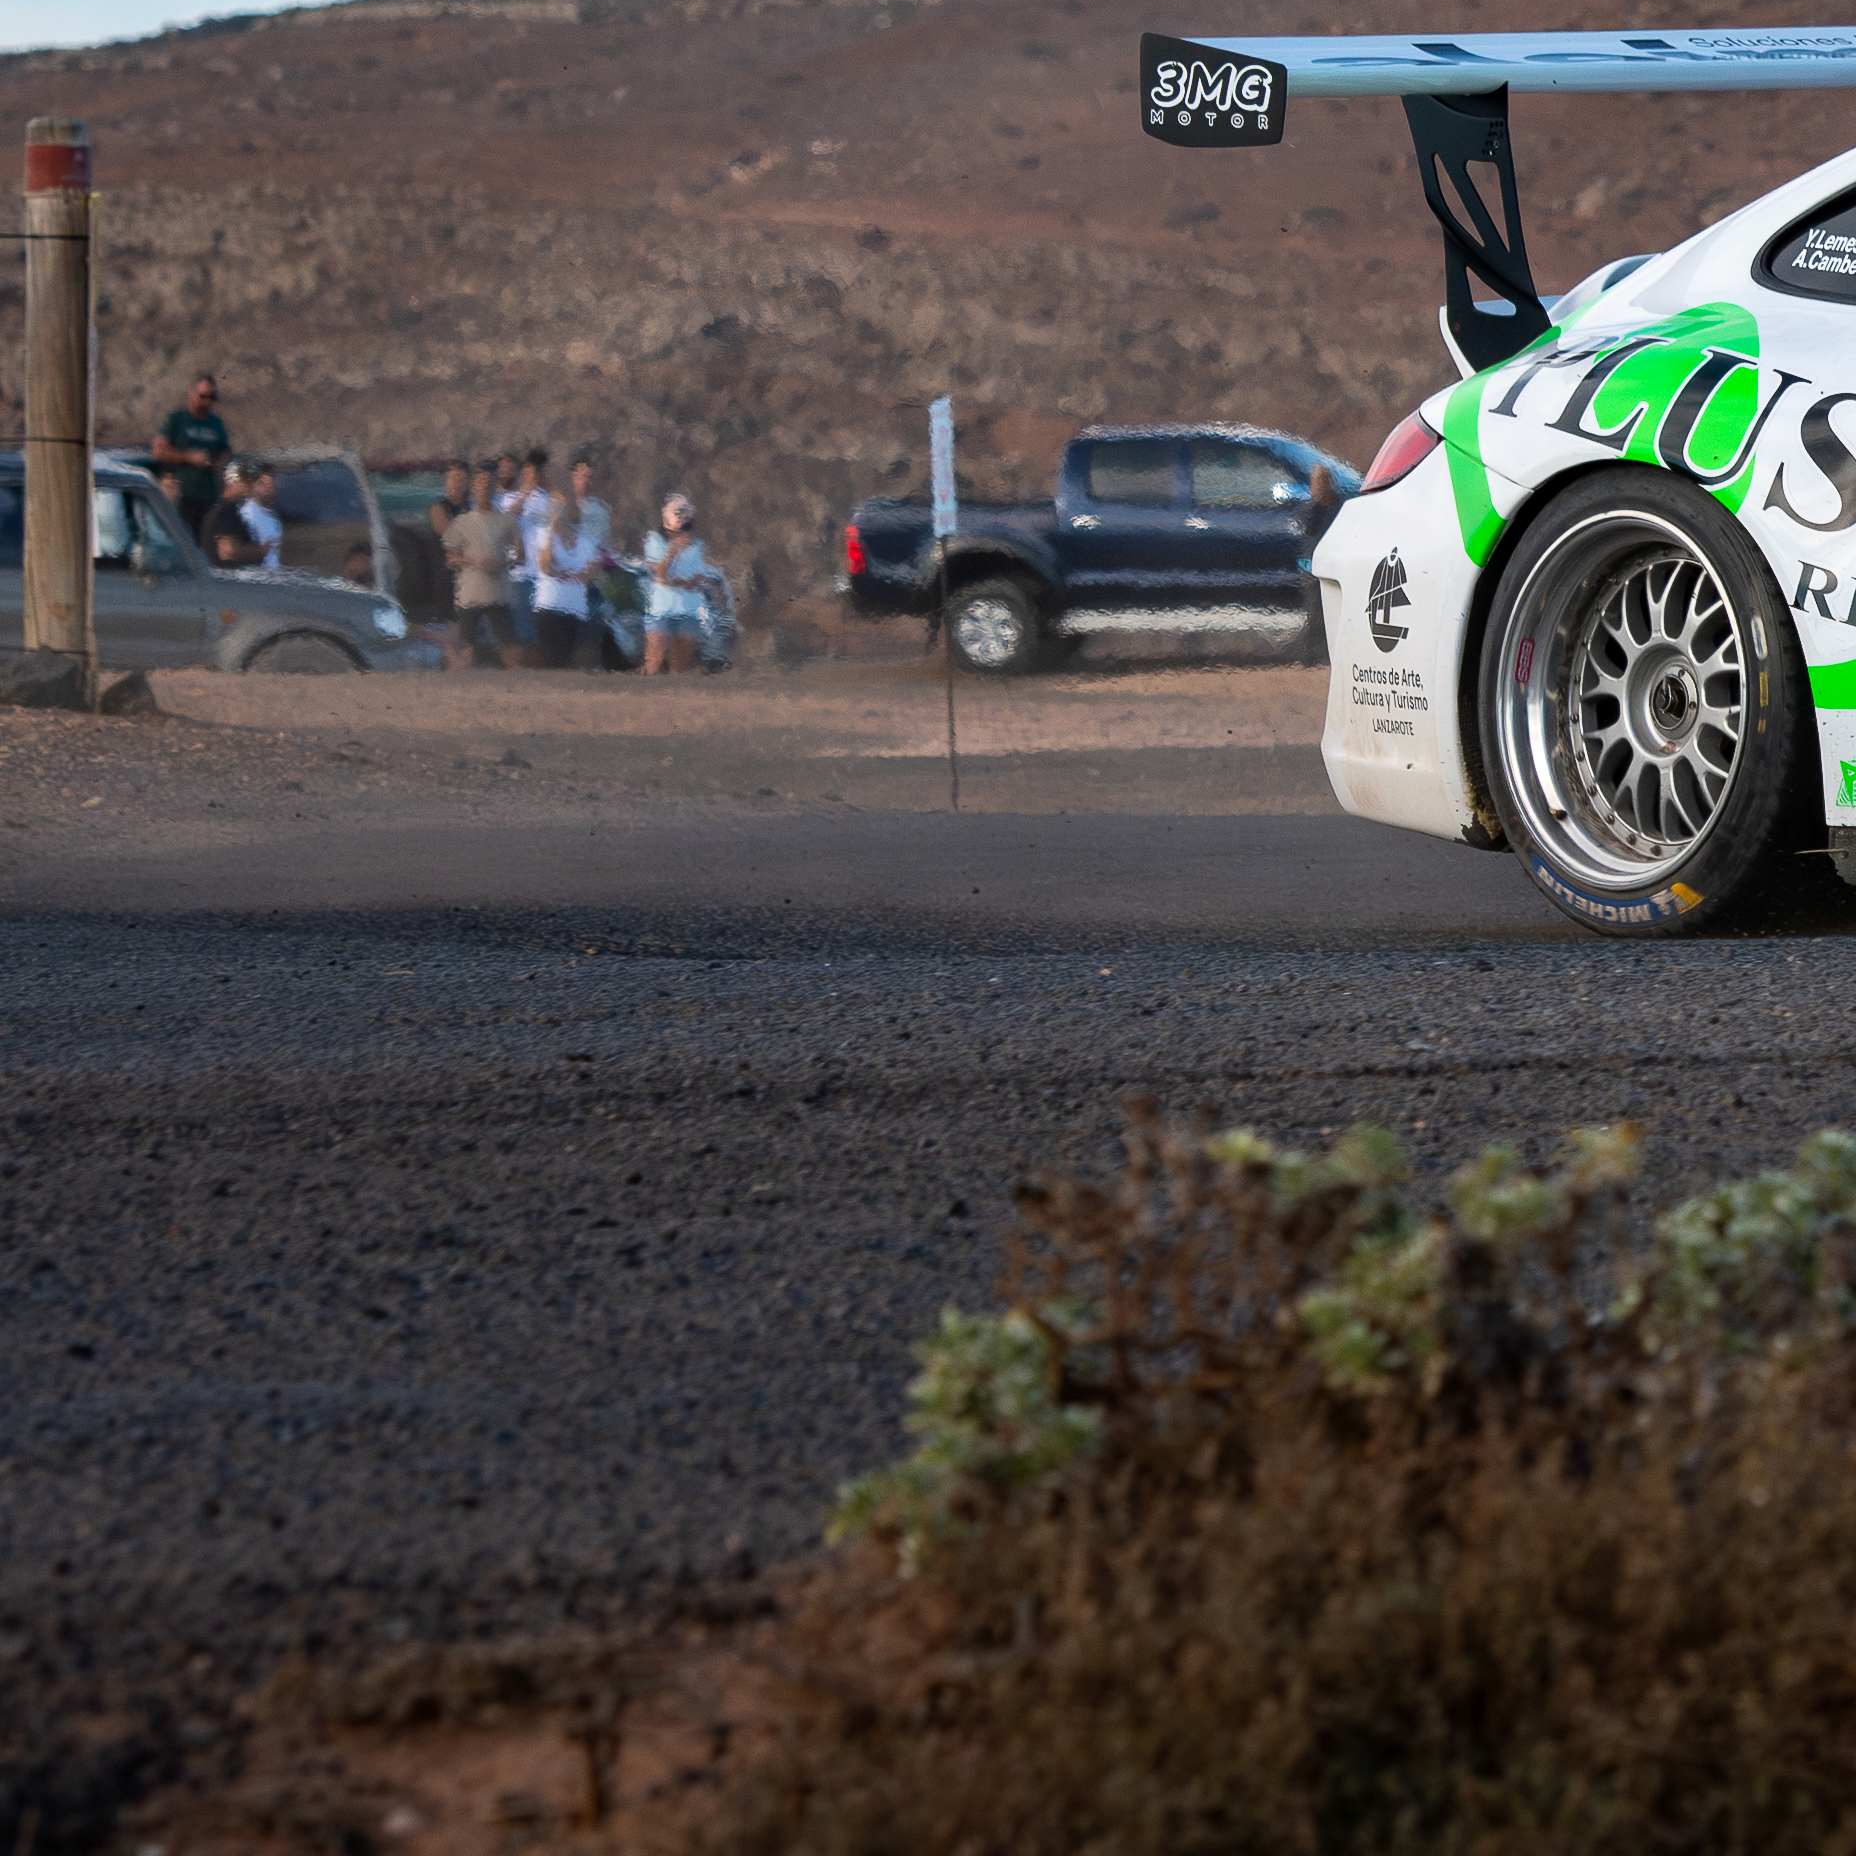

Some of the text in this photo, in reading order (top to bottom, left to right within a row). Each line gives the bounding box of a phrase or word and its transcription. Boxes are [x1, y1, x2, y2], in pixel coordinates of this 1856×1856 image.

[1688, 34, 1852, 48] Soluciones
[1150, 60, 1273, 112] 3MG
[1150, 109, 1269, 130] MOTOR
[1352, 663, 1424, 691] Centros de Arte,
[1352, 686, 1429, 713] Cultura y Turismo
[1372, 719, 1415, 737] LANZAROTE
